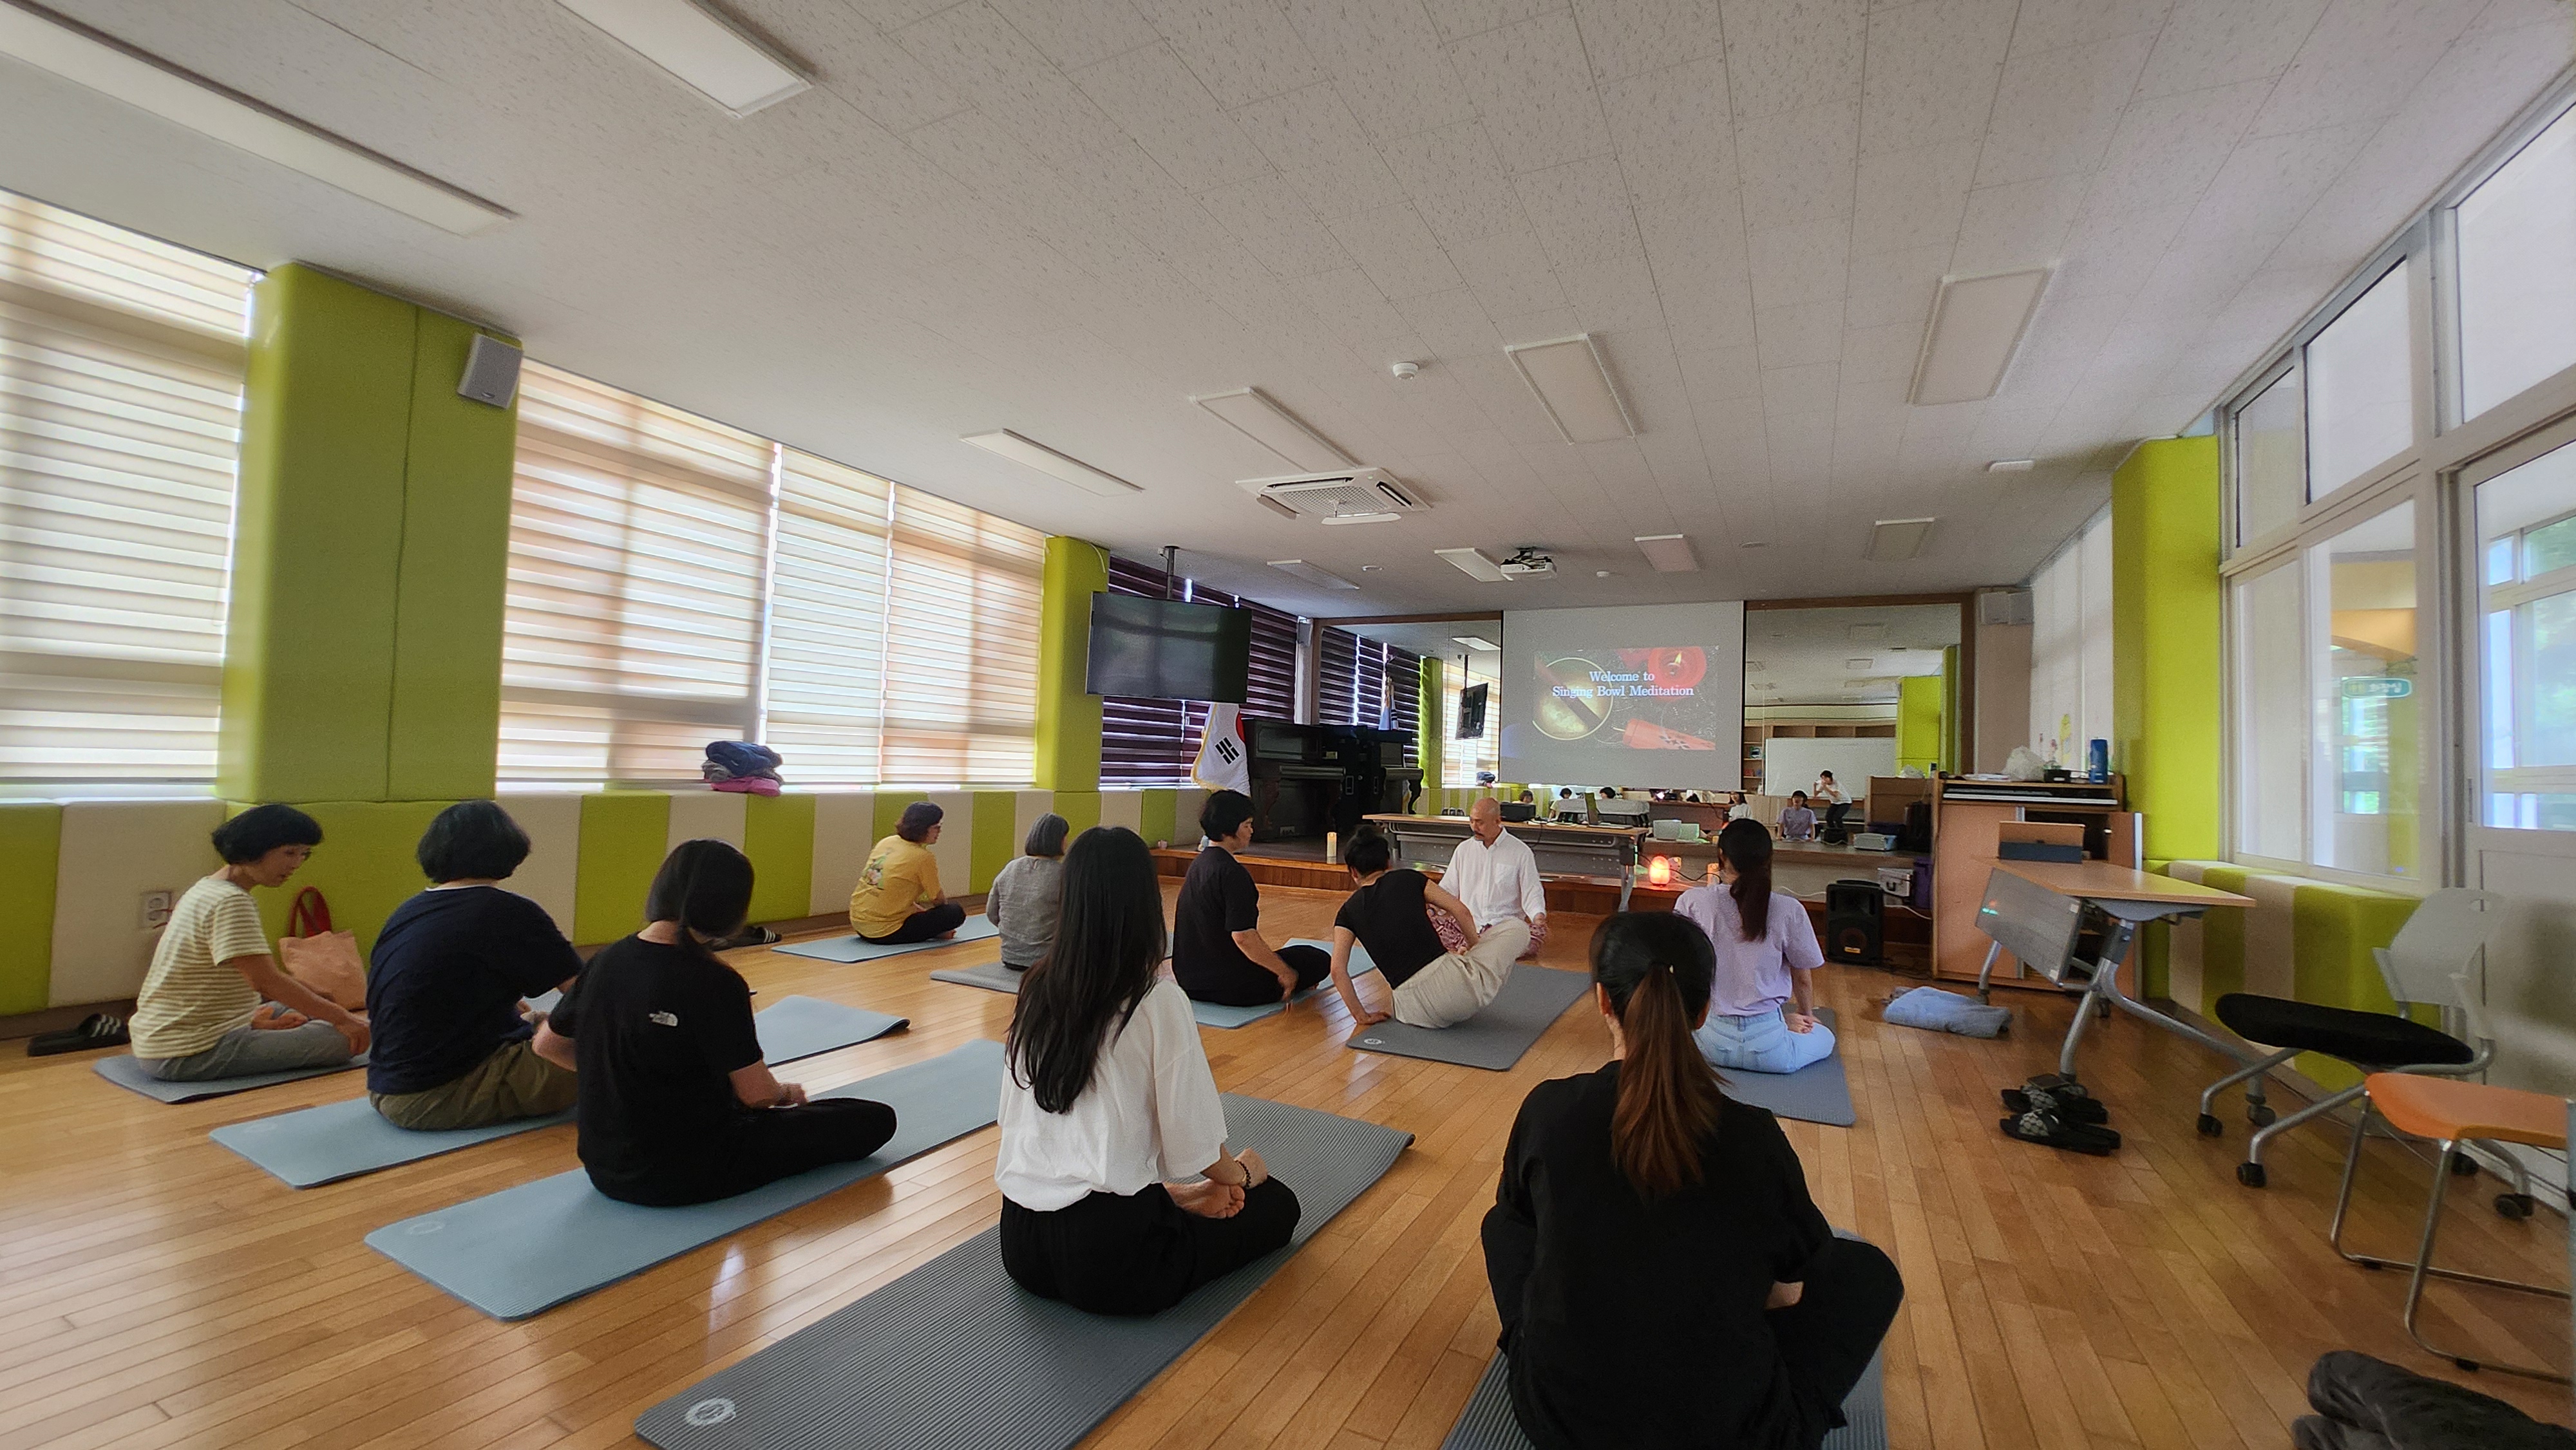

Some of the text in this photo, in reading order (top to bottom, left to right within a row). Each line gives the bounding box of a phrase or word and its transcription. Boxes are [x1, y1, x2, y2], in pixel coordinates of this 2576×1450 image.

[1589, 671, 1655, 682] Welcome to
[1553, 685, 1694, 698] Singing Bowl Meditation
